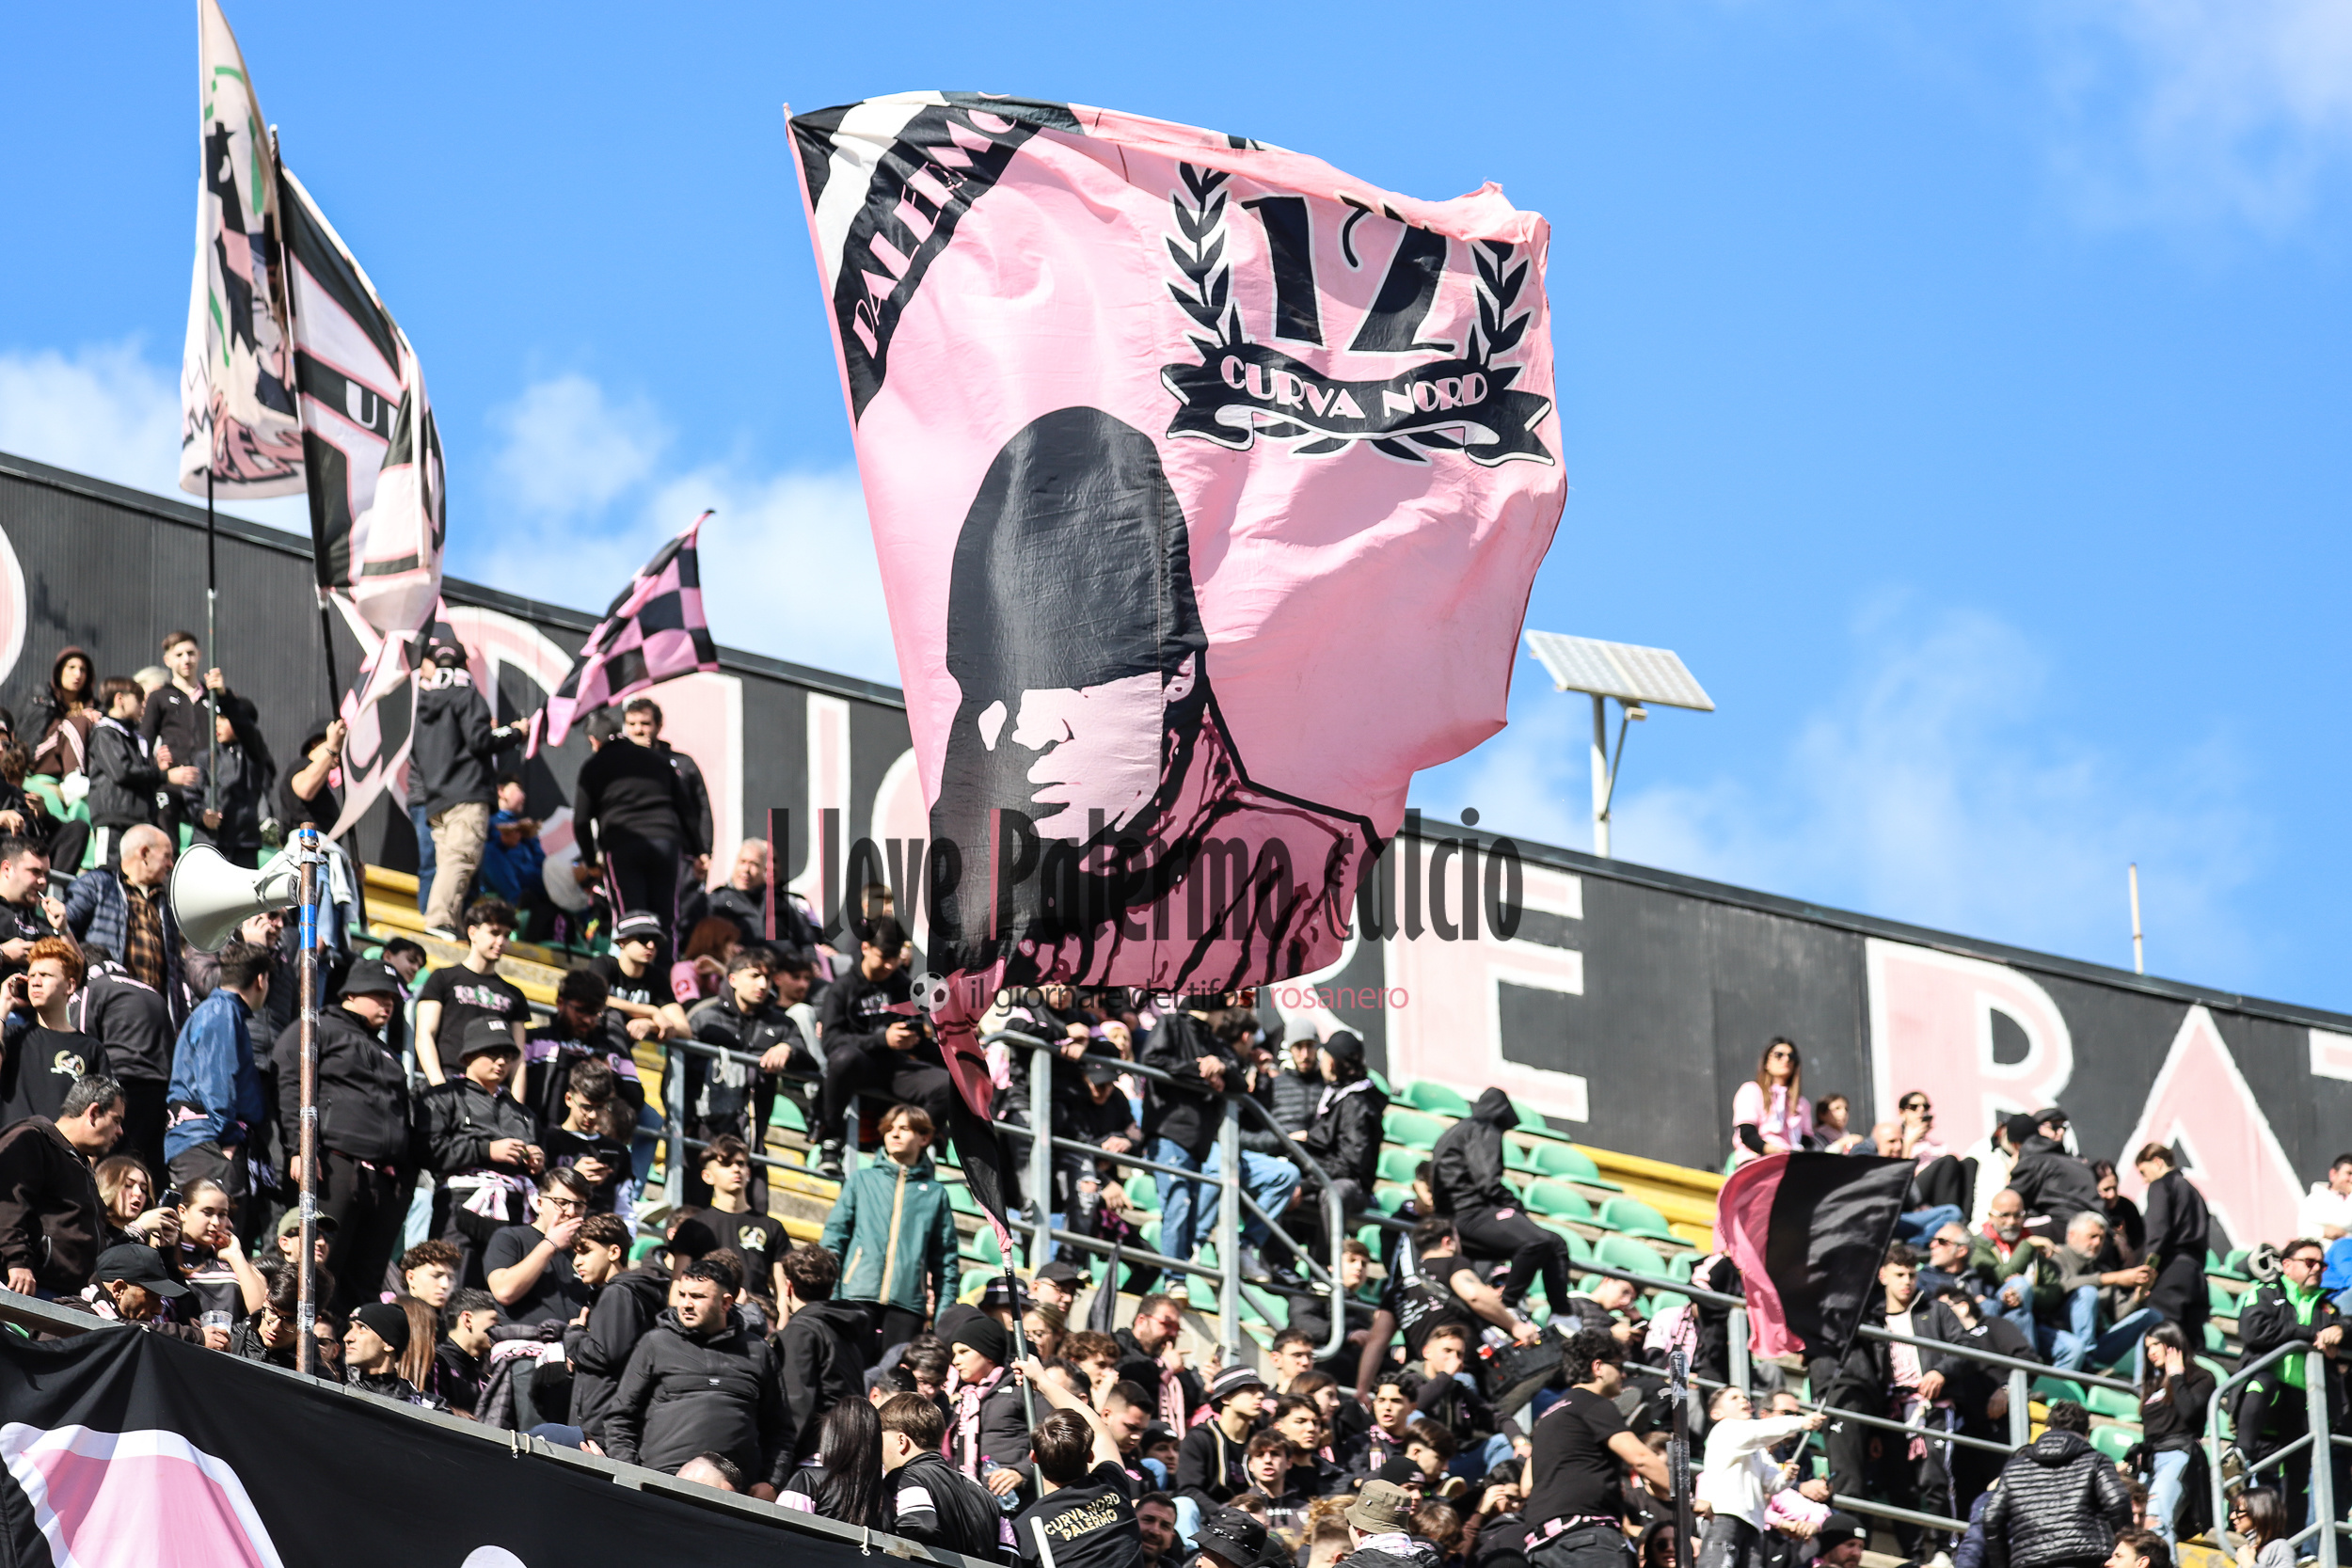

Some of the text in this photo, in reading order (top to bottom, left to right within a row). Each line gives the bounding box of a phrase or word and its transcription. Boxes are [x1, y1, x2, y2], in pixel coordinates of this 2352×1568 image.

[1240, 195, 1460, 356] 12
[1220, 355, 1488, 420] CURVA NORD
[1043, 1507, 1089, 1535] CURVA
[1060, 1508, 1119, 1542] PALERMO
